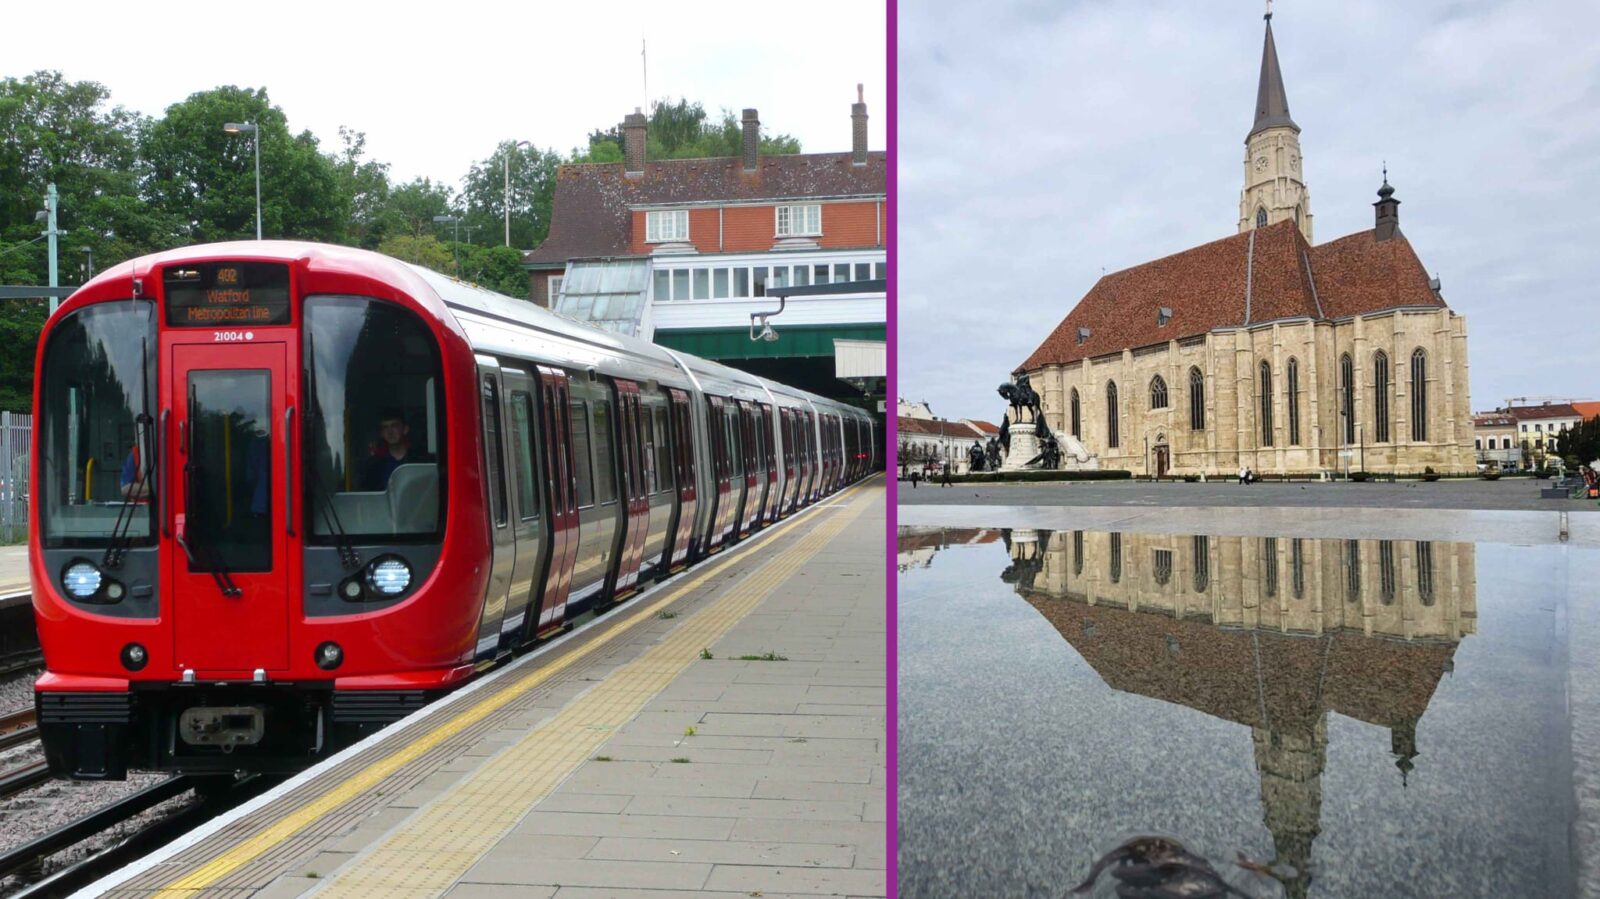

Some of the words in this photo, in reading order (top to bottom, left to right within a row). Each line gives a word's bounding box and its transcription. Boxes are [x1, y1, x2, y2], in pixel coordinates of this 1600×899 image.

[207, 289, 249, 303] Watford
[188, 306, 250, 321] Metropolitan
[253, 306, 270, 320] line
[214, 331, 243, 341] 21004
